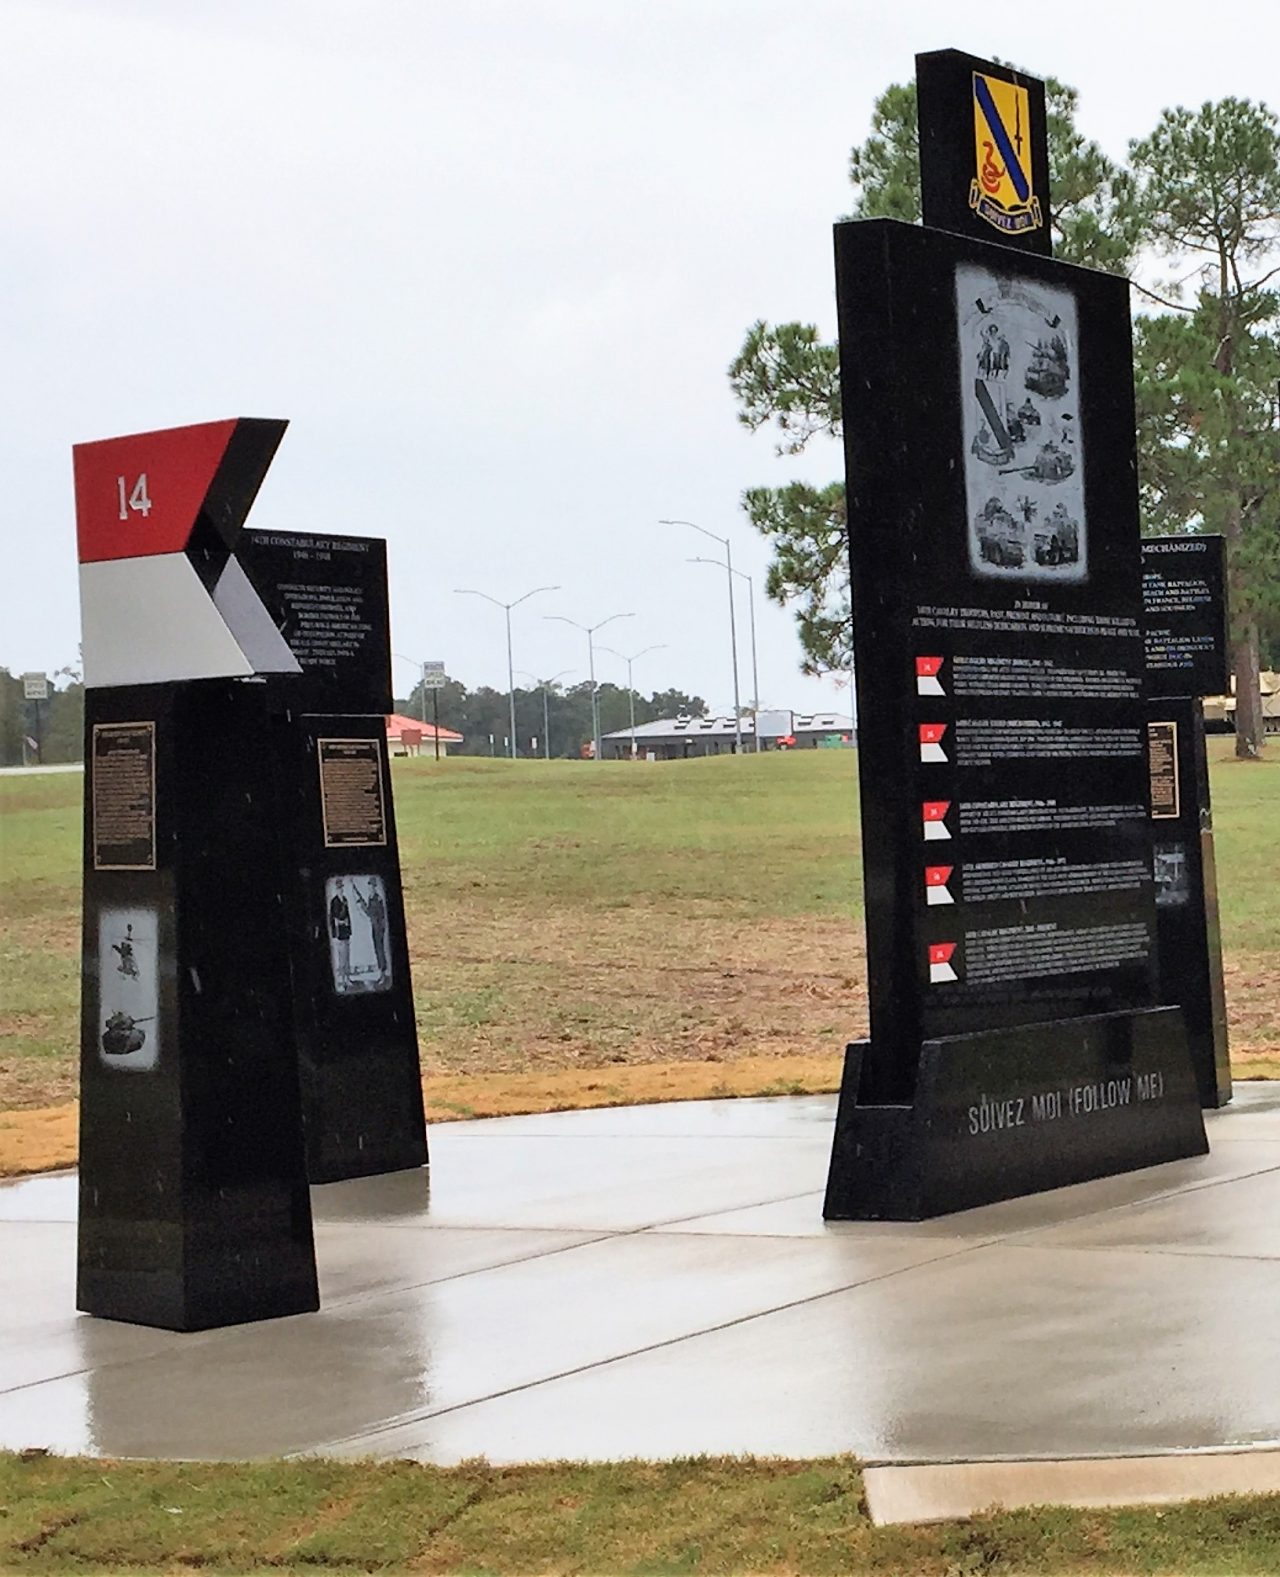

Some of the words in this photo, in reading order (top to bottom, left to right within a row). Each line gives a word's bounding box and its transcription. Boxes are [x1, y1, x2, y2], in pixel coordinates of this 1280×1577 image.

[117, 472, 152, 521] 14
[1032, 1090, 1062, 1121] MOI
[1069, 1077, 1131, 1118] (FOLLOW
[1136, 1070, 1164, 1101] ME)
